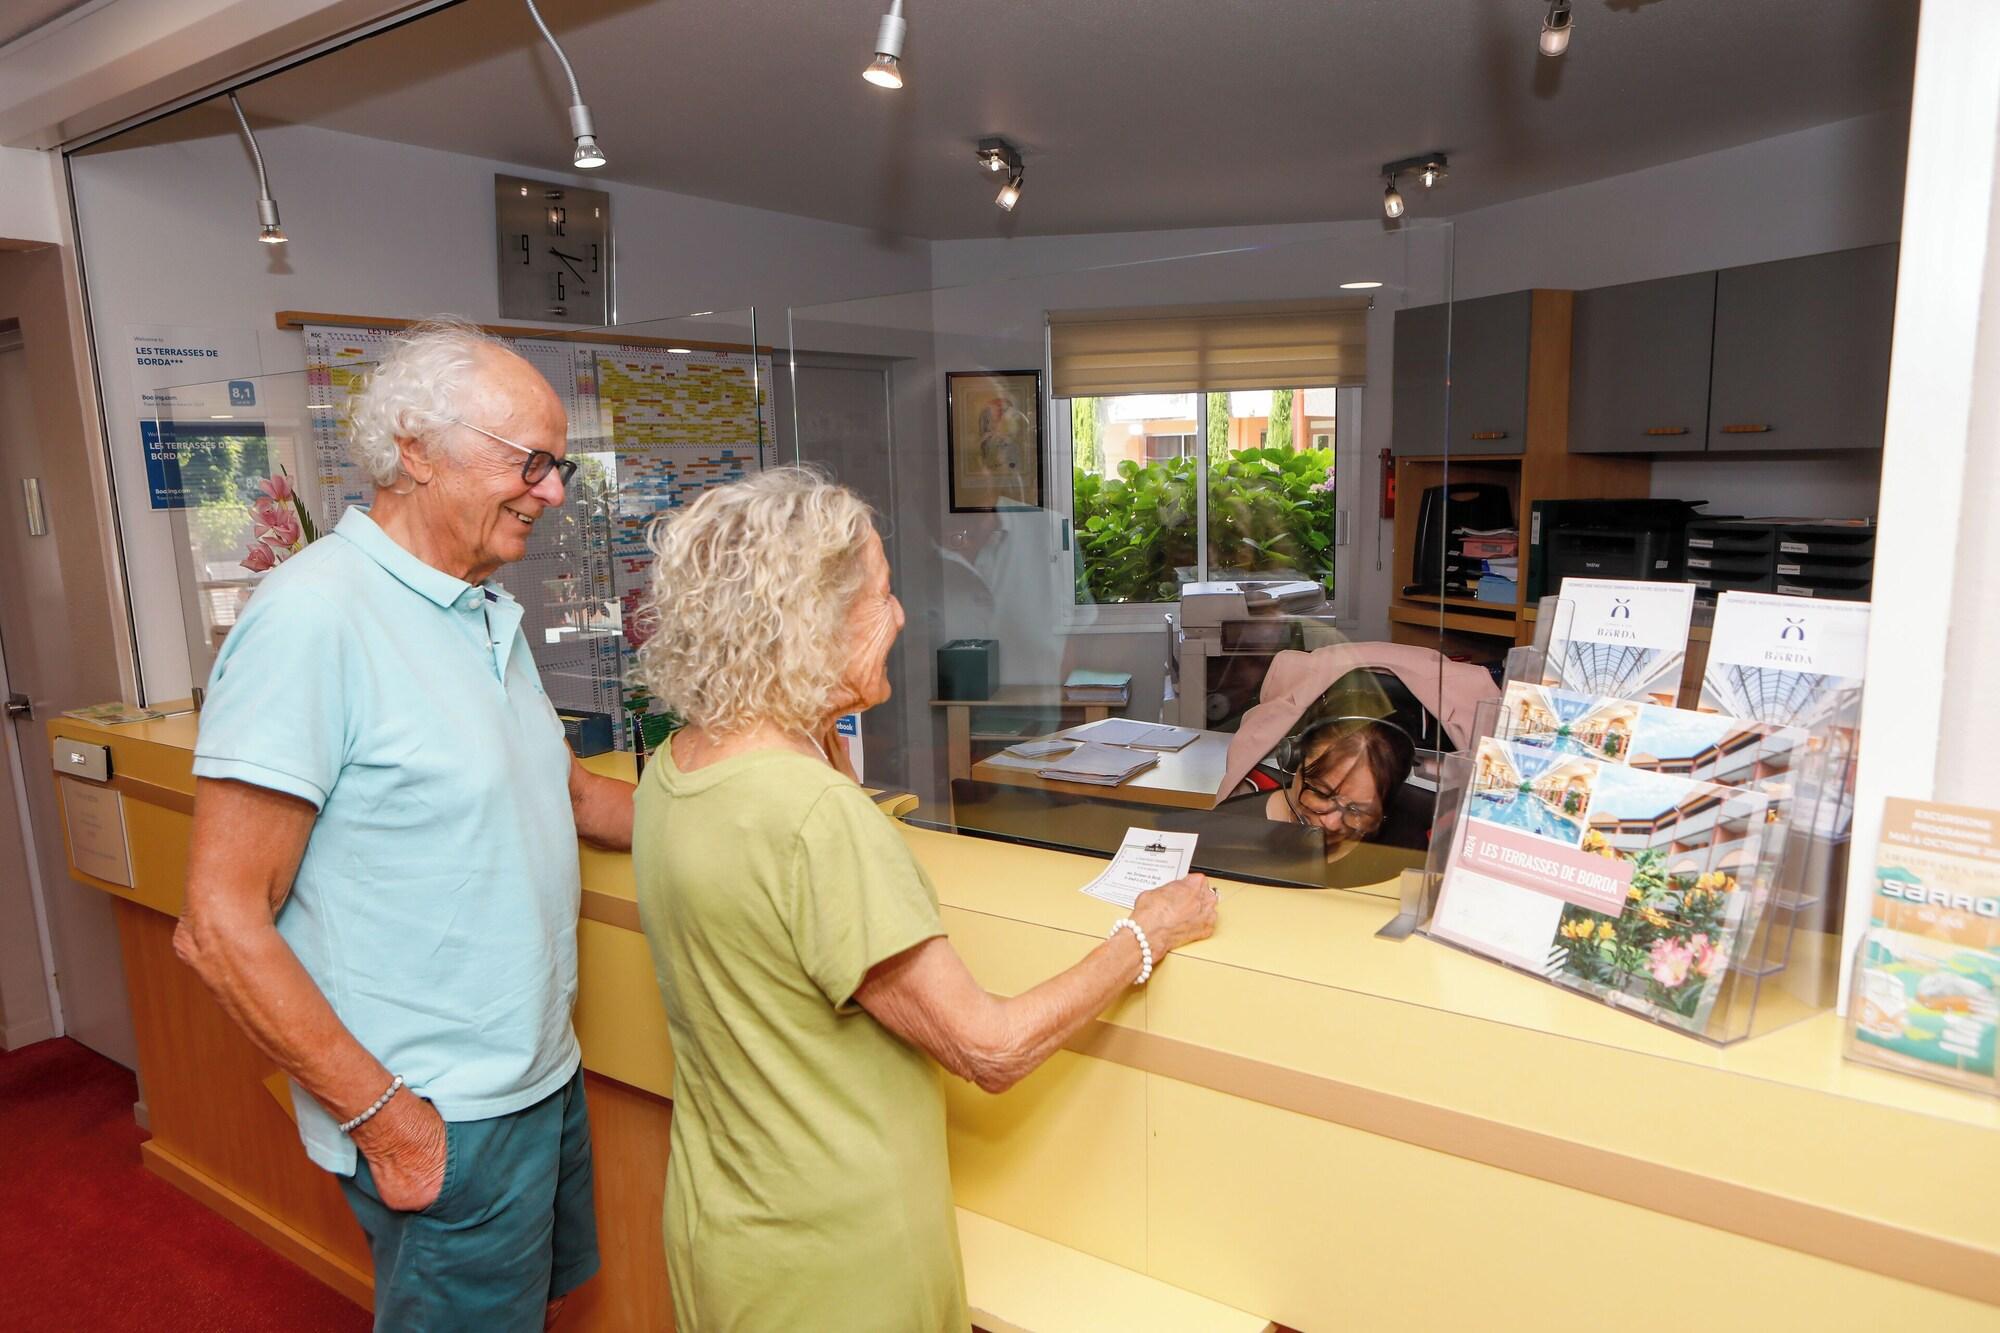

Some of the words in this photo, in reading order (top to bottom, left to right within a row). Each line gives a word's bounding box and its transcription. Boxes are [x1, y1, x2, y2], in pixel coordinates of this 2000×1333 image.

[521, 234, 530, 265] 9
[591, 243, 598, 273] 3
[557, 271, 565, 301] 6
[135, 347, 152, 355] LES
[153, 347, 204, 357] TERRASSES
[232, 387, 251, 400] 8,1
[165, 441, 217, 450] TERRASSES
[1464, 835, 1477, 859] 2024
[1480, 841, 1500, 860] LES
[1500, 846, 1561, 878] TERRASSES
[1560, 863, 1577, 883] DE
[1577, 868, 1619, 895] BORDA
